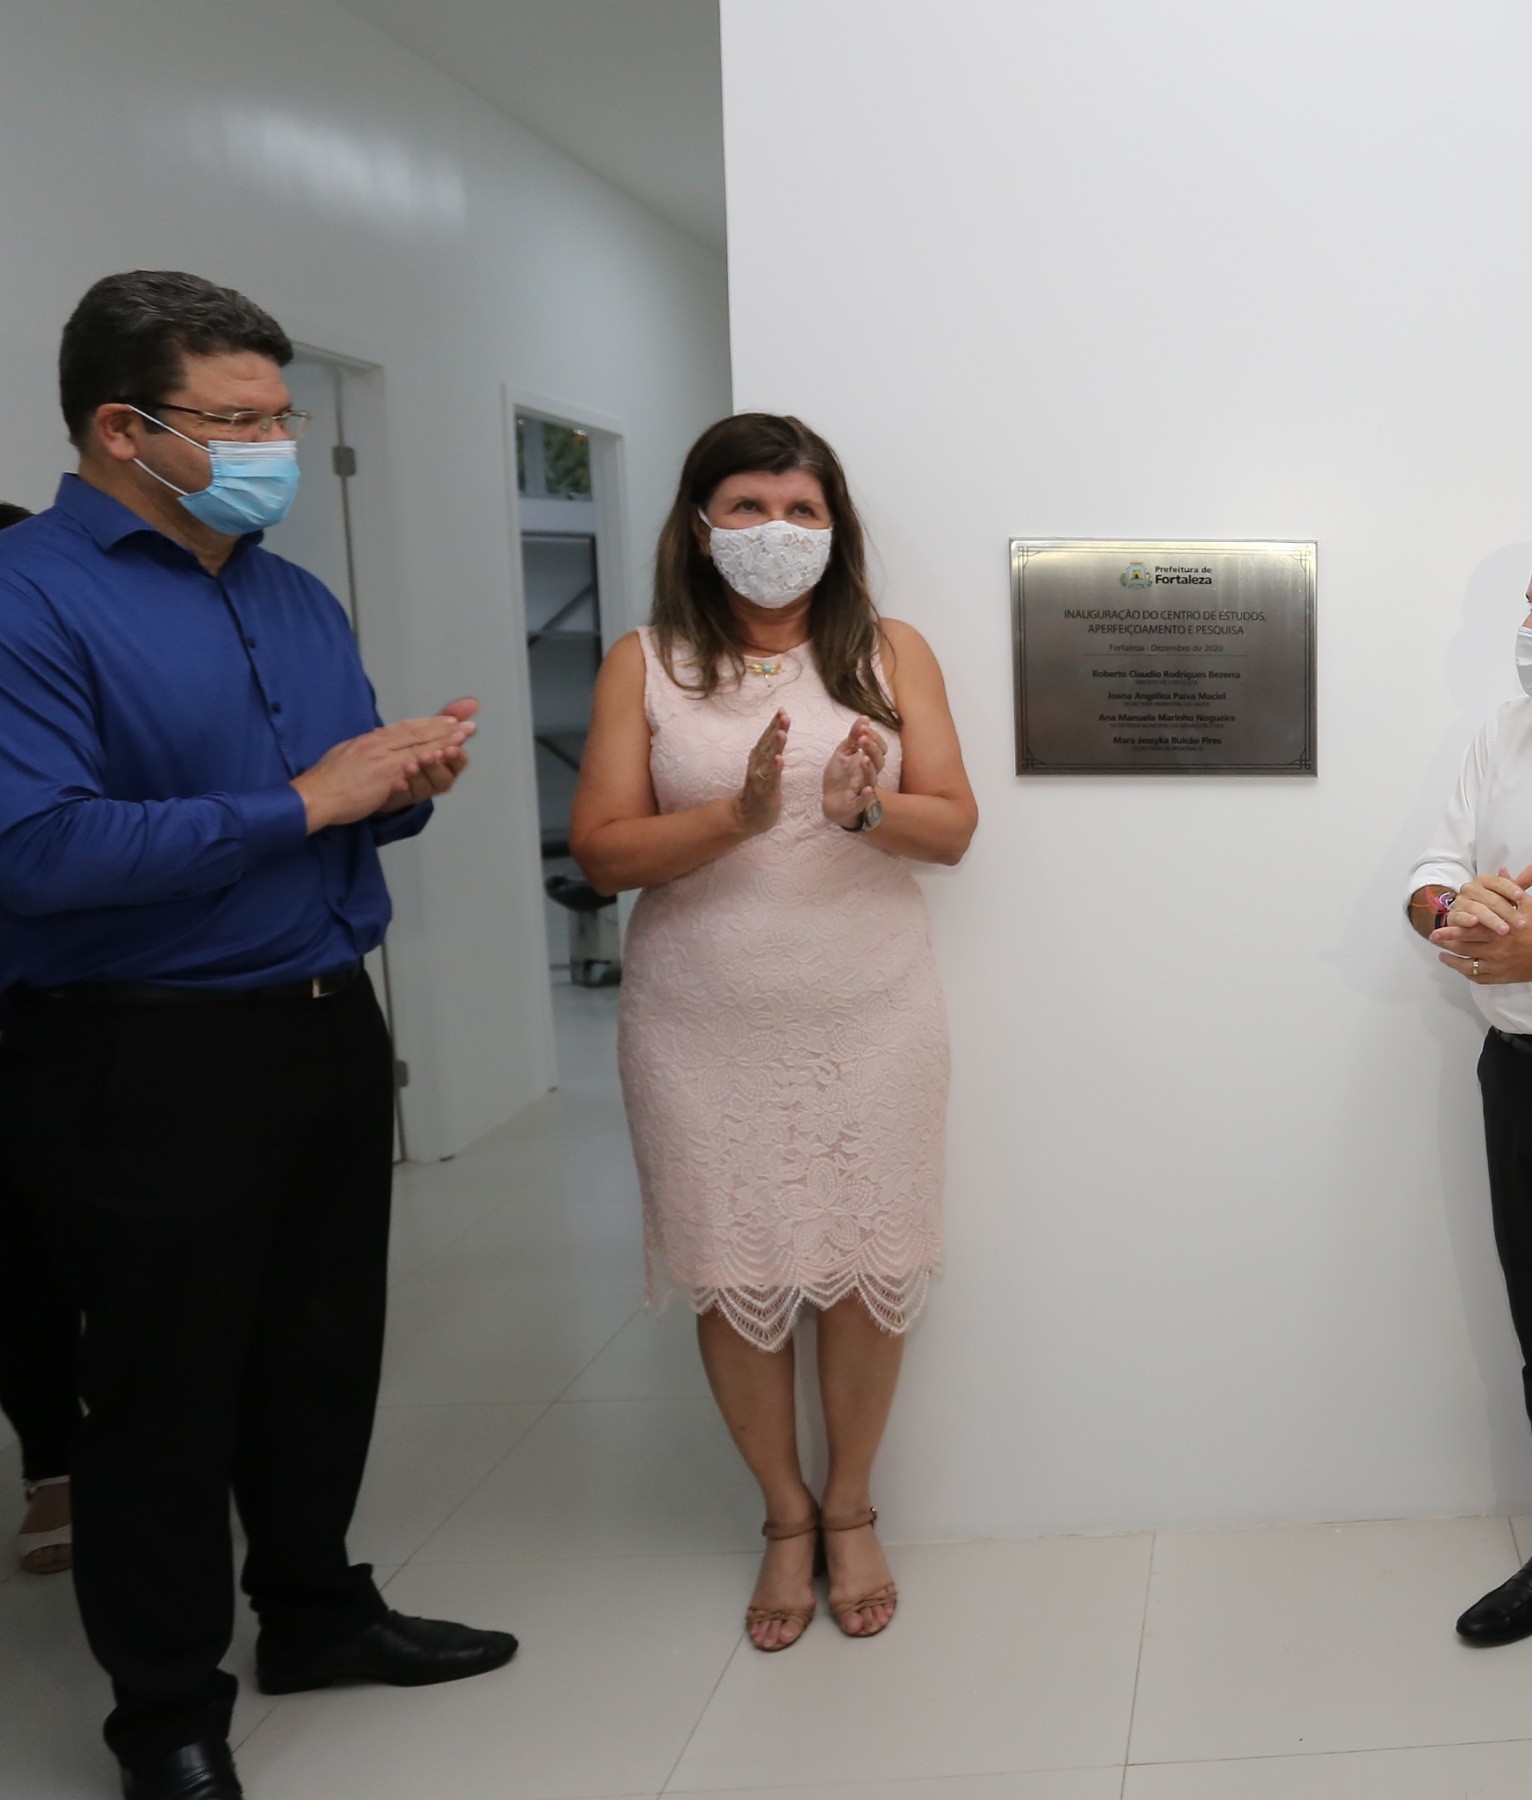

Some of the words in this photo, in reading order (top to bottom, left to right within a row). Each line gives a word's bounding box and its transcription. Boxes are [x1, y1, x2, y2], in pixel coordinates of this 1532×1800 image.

[1155, 566, 1198, 574] Prefeitura
[1201, 566, 1212, 574] de
[1155, 575, 1212, 585] Fortaleza
[1064, 608, 1140, 621] INAUGURAÇÃO
[1142, 610, 1158, 620] DO
[1160, 610, 1200, 620] CENTRO
[1203, 610, 1217, 620] DE
[1218, 610, 1267, 621] ESTUDOS,
[1088, 624, 1186, 637] APERFEIÇOAMENTO
[1188, 625, 1193, 634] E
[1195, 625, 1244, 635] PESQUISA
[1109, 644, 1145, 652] Fortaleza
[1150, 644, 1191, 652] Dezembro
[1192, 644, 1203, 652] de
[1092, 670, 1127, 678] Roberto
[1163, 670, 1206, 680] Rodrigues
[1208, 671, 1241, 679] Bezerra
[1107, 692, 1132, 700] Joana
[1134, 692, 1171, 702] Angélica
[1173, 692, 1196, 700] Paiva
[1198, 692, 1226, 700] Maciel
[1099, 714, 1116, 722] Ana
[1118, 714, 1156, 722] Manuela
[1157, 714, 1194, 722] Marinho
[1196, 714, 1235, 724] Nogueira
[1202, 737, 1222, 745] Pires
